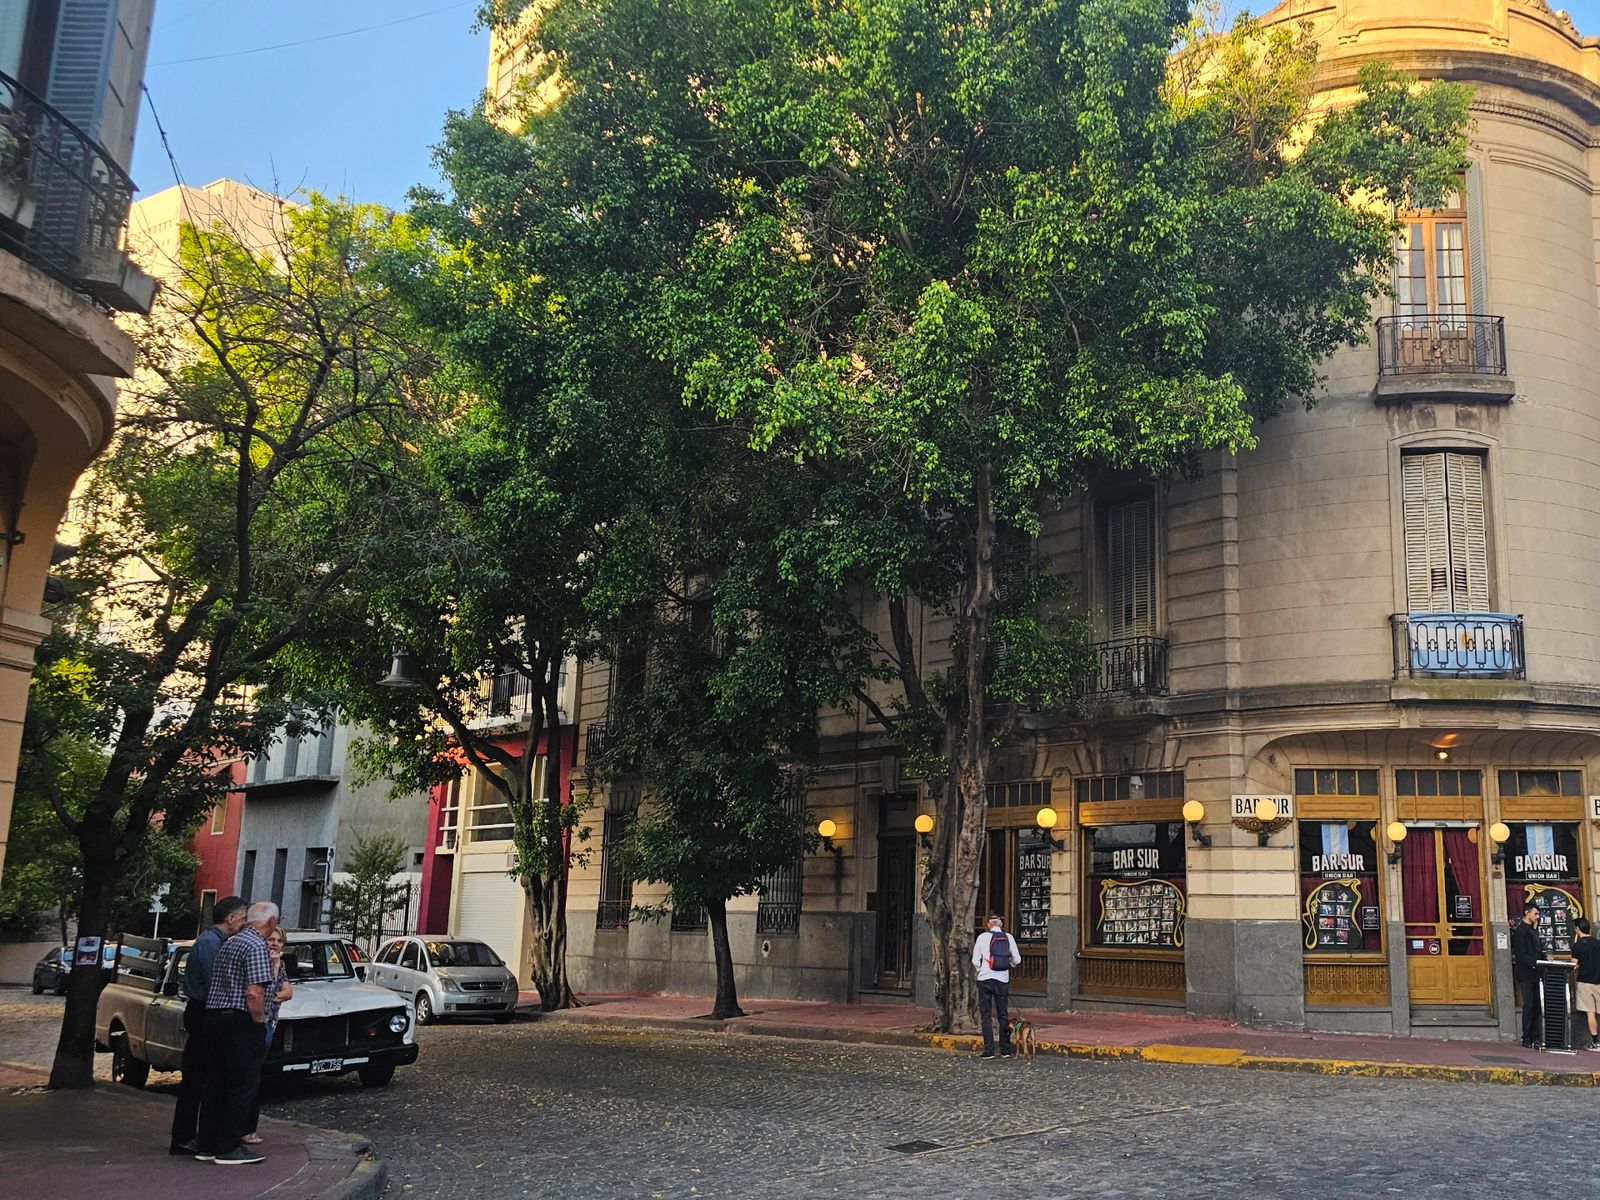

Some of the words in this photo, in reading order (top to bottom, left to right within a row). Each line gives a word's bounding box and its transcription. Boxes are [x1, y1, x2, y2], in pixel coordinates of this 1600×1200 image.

[1020, 854, 1036, 870] BAR
[1113, 849, 1134, 870] BAR
[1137, 848, 1159, 869] SUR
[1312, 853, 1339, 872] BAR
[1340, 853, 1365, 871] SUR
[1515, 854, 1541, 872] BAR
[1543, 854, 1568, 871] SUR
